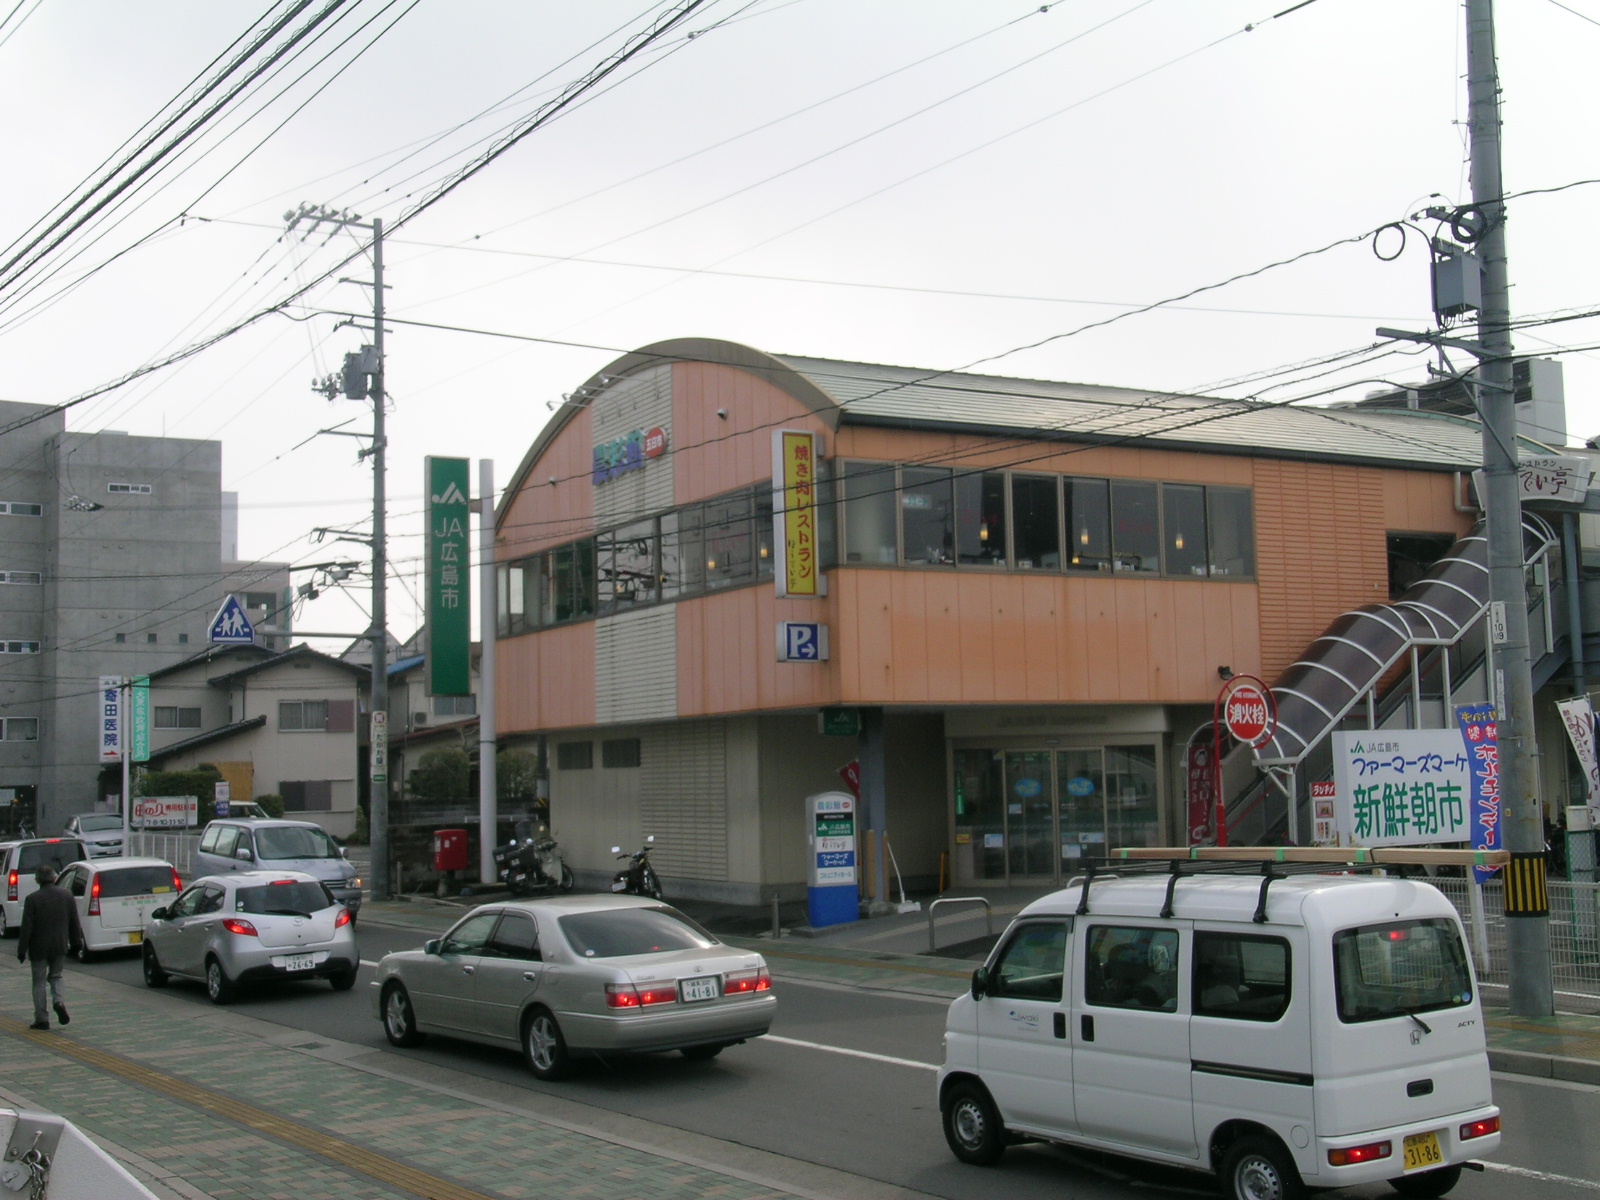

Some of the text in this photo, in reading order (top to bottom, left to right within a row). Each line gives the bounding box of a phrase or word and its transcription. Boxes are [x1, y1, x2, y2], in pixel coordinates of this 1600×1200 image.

[794, 445, 811, 578] 焼き肉レストラン
[435, 517, 464, 609] JA広島市
[1229, 703, 1264, 724] 消火栓
[1367, 742, 1399, 753] JA広島市
[1353, 780, 1463, 839] 新鮮朝市
[692, 985, 715, 998] 41-81
[1457, 1020, 1476, 1028] ACTY
[1408, 1144, 1439, 1165] 31-86
